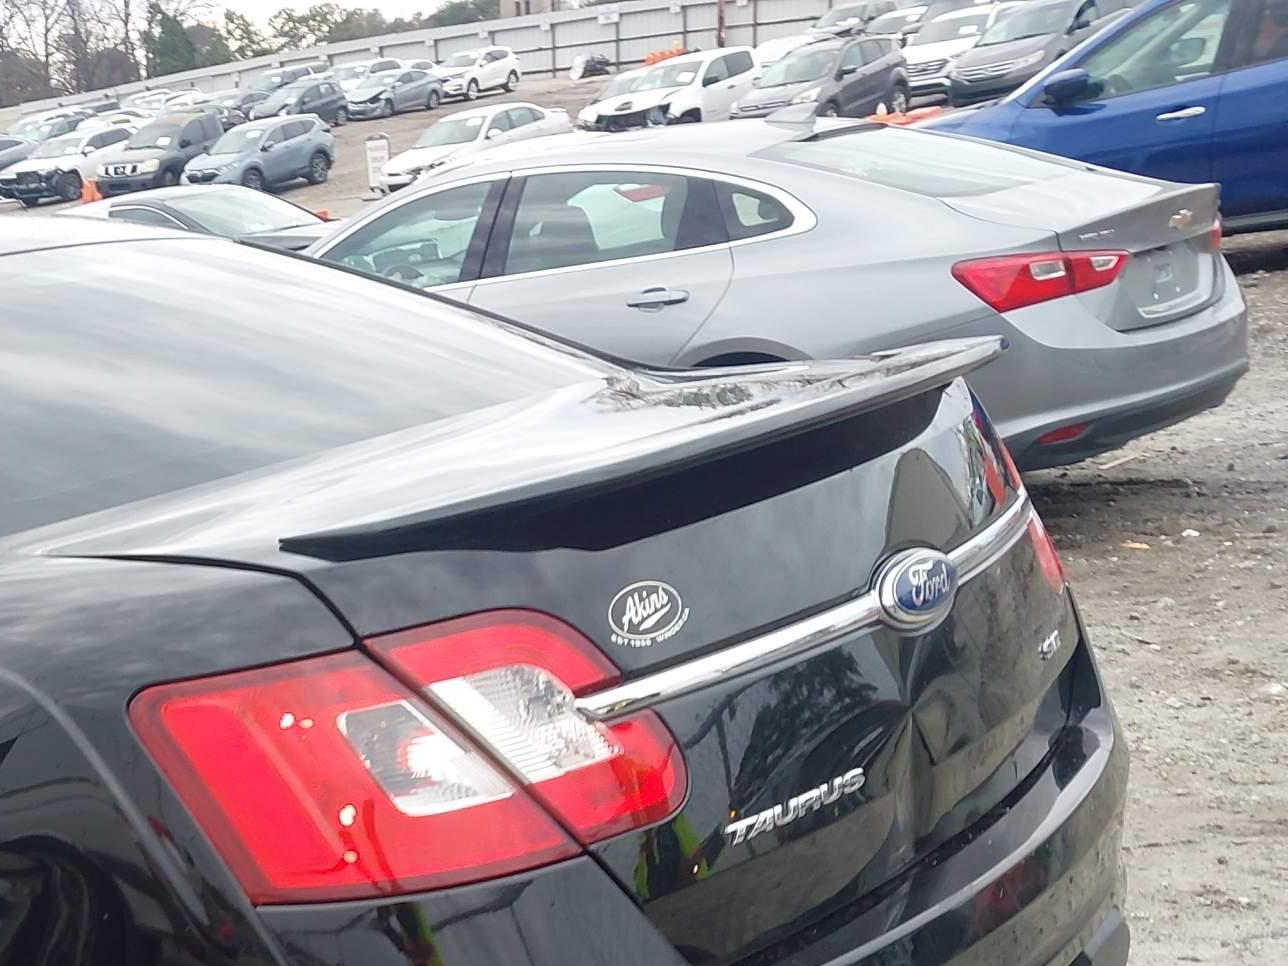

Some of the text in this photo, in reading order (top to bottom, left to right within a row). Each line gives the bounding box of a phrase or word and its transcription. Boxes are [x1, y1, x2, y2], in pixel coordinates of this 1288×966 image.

[908, 560, 951, 607] Ford
[622, 585, 669, 633] Akins
[724, 767, 866, 846] TAURUS
